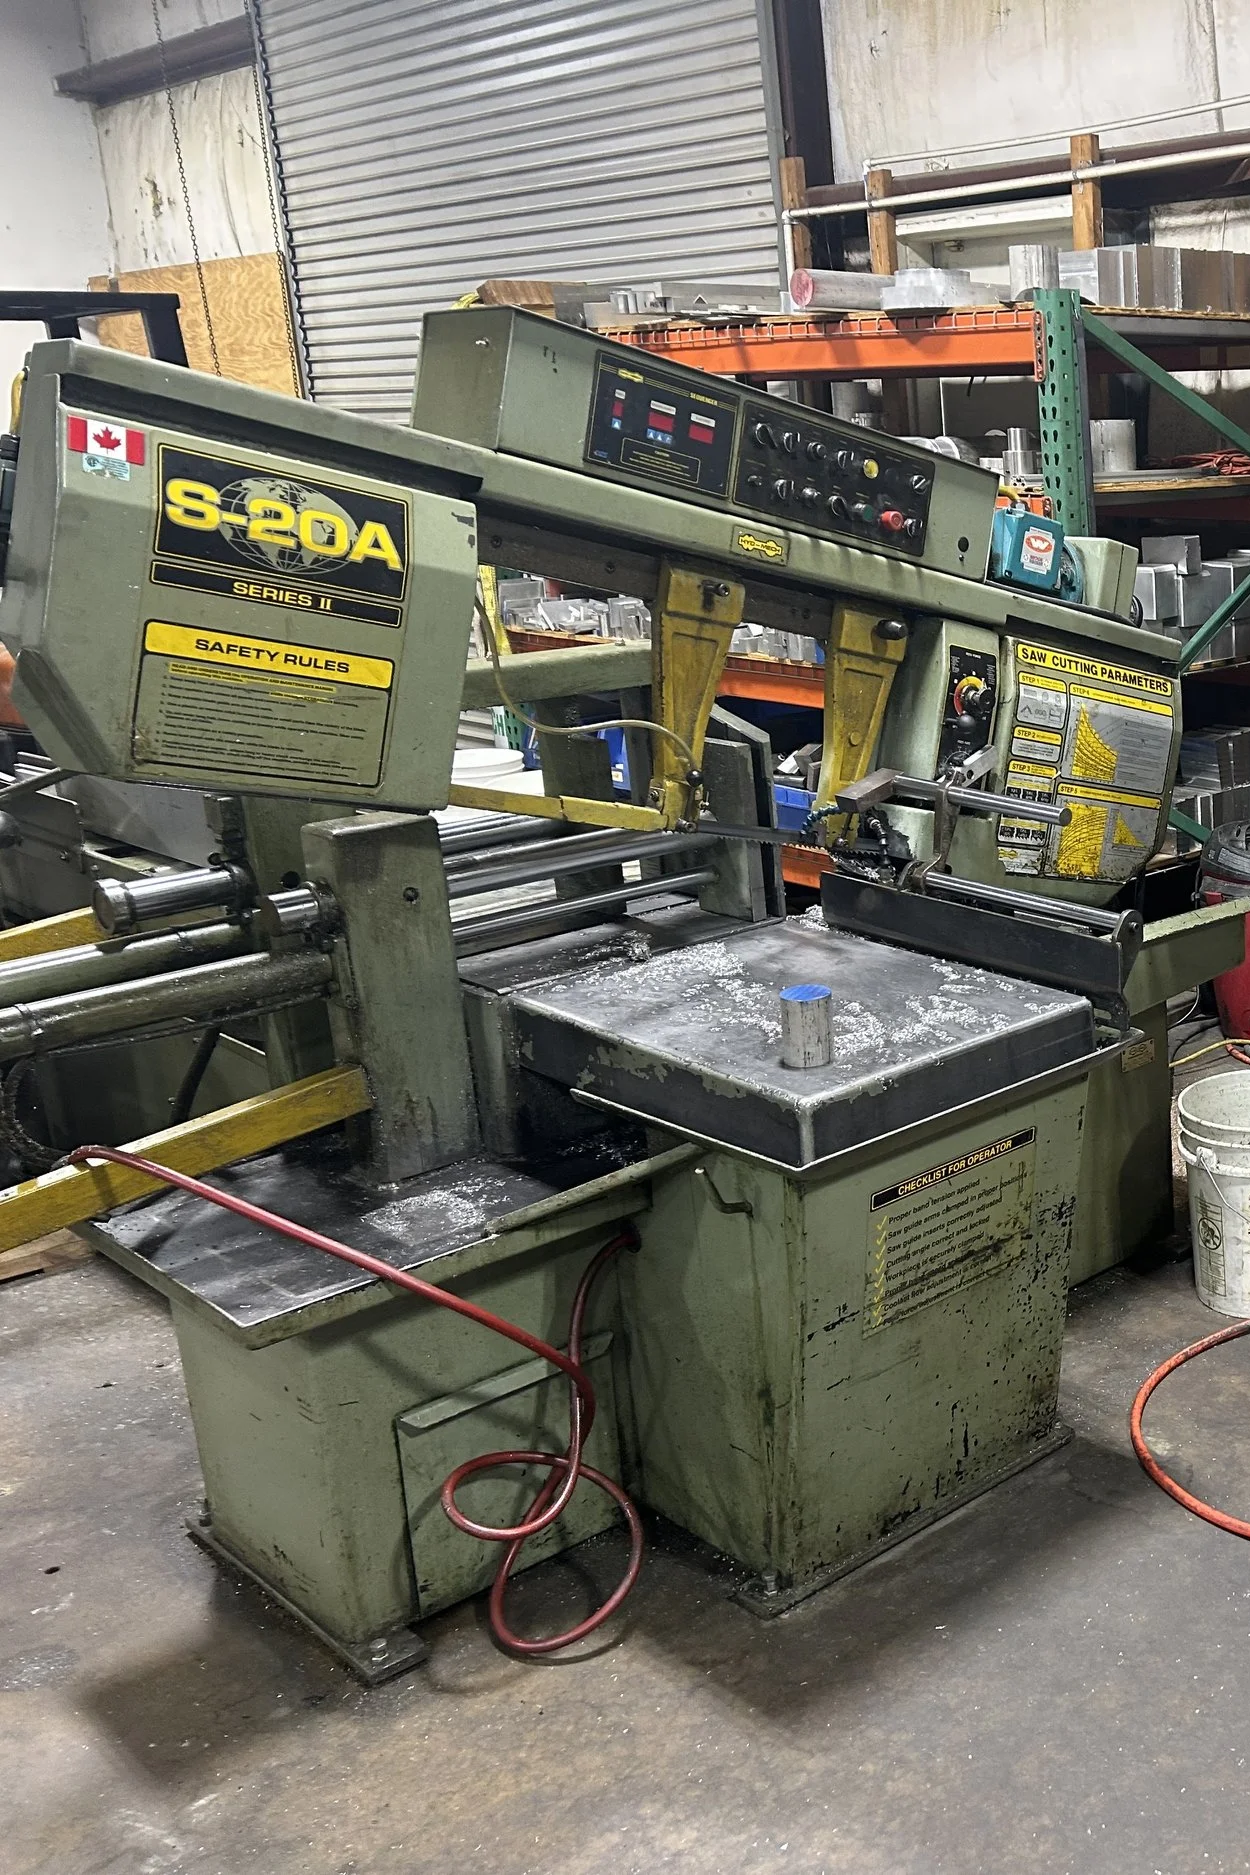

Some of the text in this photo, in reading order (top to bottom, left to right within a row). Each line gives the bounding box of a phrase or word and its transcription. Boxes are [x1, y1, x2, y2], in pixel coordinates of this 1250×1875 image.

[165, 478, 405, 572] S-20A
[233, 581, 332, 611] SERIES II
[195, 638, 350, 674] SAFETY RULES
[1021, 648, 1169, 693] SAW CUTTING PARAMETERS
[1021, 674, 1035, 683] STEP
[1072, 686, 1086, 695] STEP
[1017, 729, 1031, 737] STEP
[1011, 762, 1026, 771] STEP
[1060, 785, 1074, 794] STEP
[898, 1139, 1012, 1196] CHECKLIST FOR OPERATOR
[887, 1229, 901, 1240] Saw
[903, 1219, 923, 1234] guide
[923, 1212, 941, 1224] arms
[970, 1194, 977, 1202] in
[888, 1179, 980, 1225] Proper band tension applied
[887, 1244, 901, 1255] Saw
[902, 1233, 922, 1249] guide
[923, 1223, 946, 1238] inserts
[975, 1196, 1002, 1214] adjusted
[911, 1242, 931, 1257] angle
[931, 1233, 955, 1247] correct
[955, 1225, 968, 1237] and
[968, 1215, 991, 1230] locked
[885, 1263, 921, 1283] Workpiece
[957, 1231, 985, 1250] clamped
